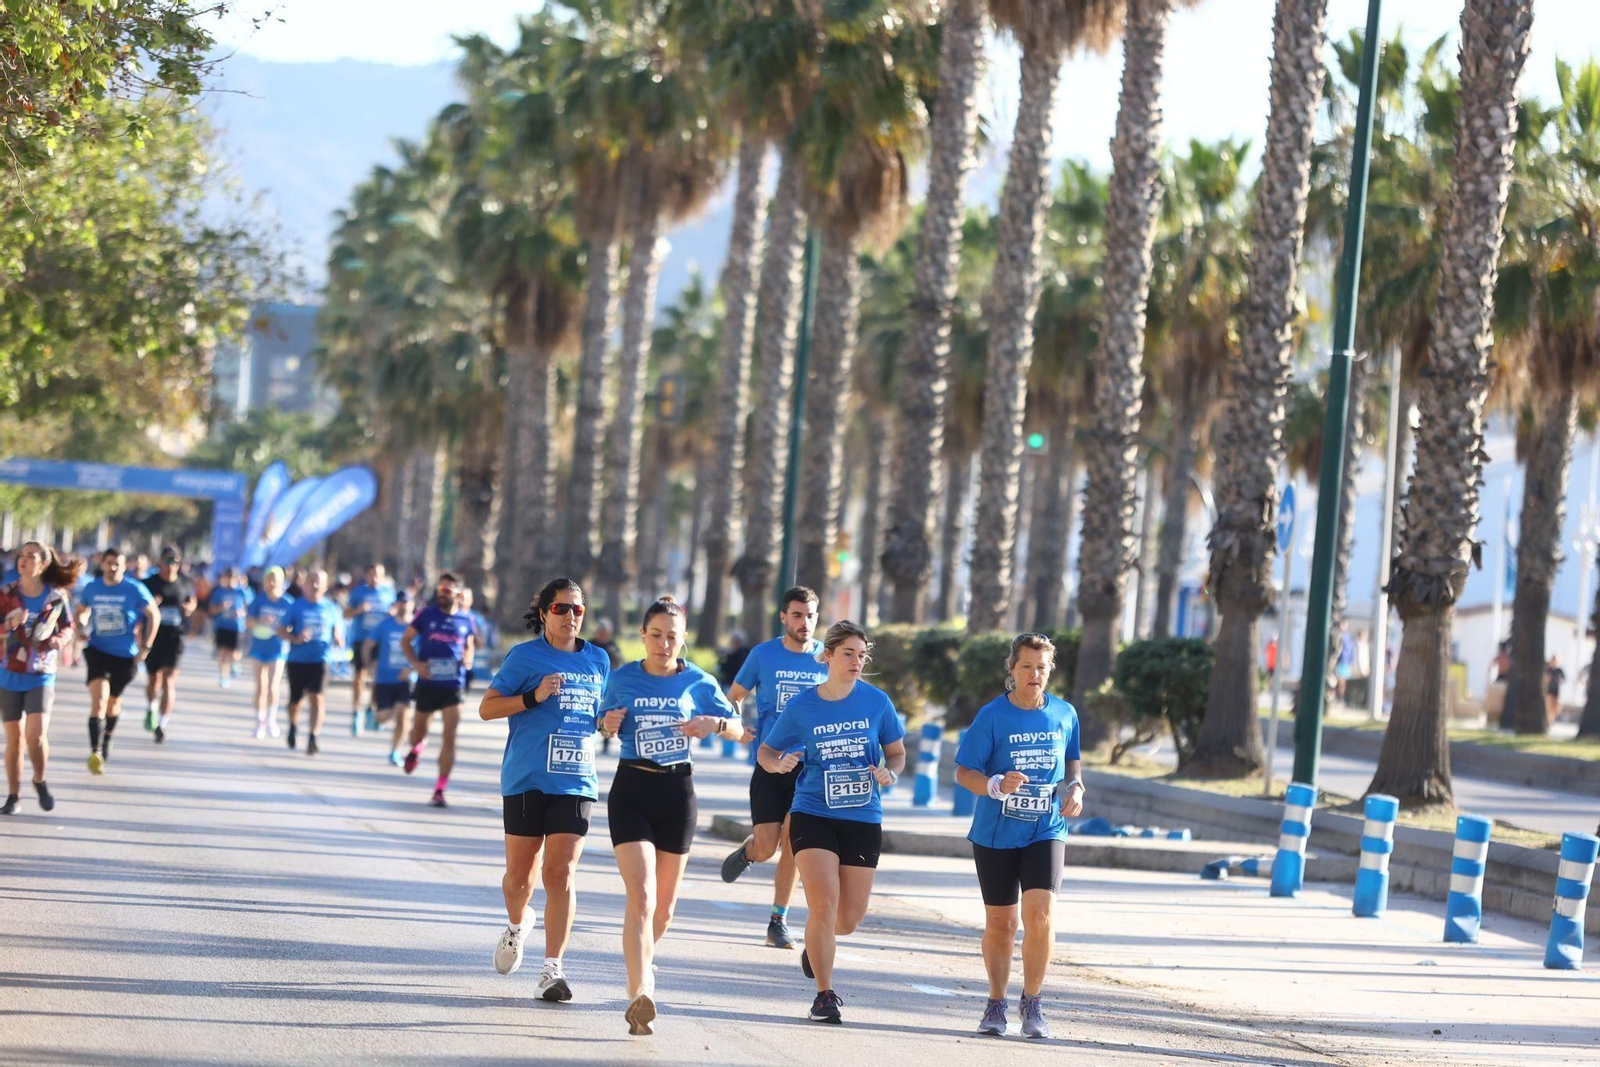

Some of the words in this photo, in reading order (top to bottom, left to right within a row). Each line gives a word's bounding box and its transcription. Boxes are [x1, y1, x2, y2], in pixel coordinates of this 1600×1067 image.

[813, 718, 870, 735] mayoral
[815, 737, 867, 749] RUNNING
[1009, 729, 1062, 744] mayoral
[644, 738, 685, 754] 2029
[821, 745, 864, 755] MAKES
[556, 749, 591, 762] 1700
[821, 751, 865, 761] FRIENDS
[832, 782, 869, 795] 2159
[1011, 797, 1046, 809] 1811
